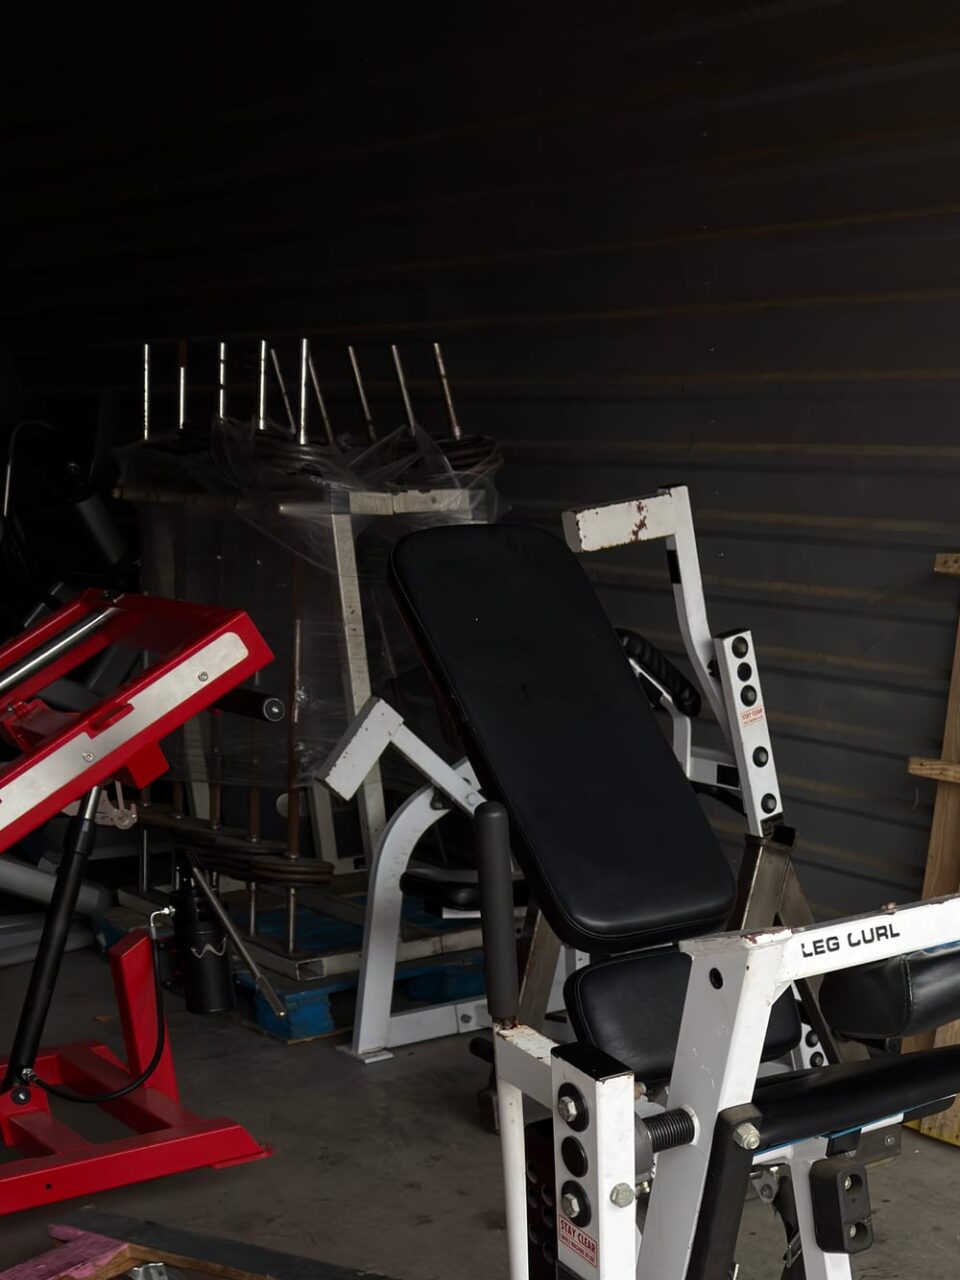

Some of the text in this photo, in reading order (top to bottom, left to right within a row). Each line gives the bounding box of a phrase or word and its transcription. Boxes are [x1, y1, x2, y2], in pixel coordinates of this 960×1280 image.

[801, 923, 900, 958] LEG CURL
[561, 1219, 596, 1254] STAY CLEAR
